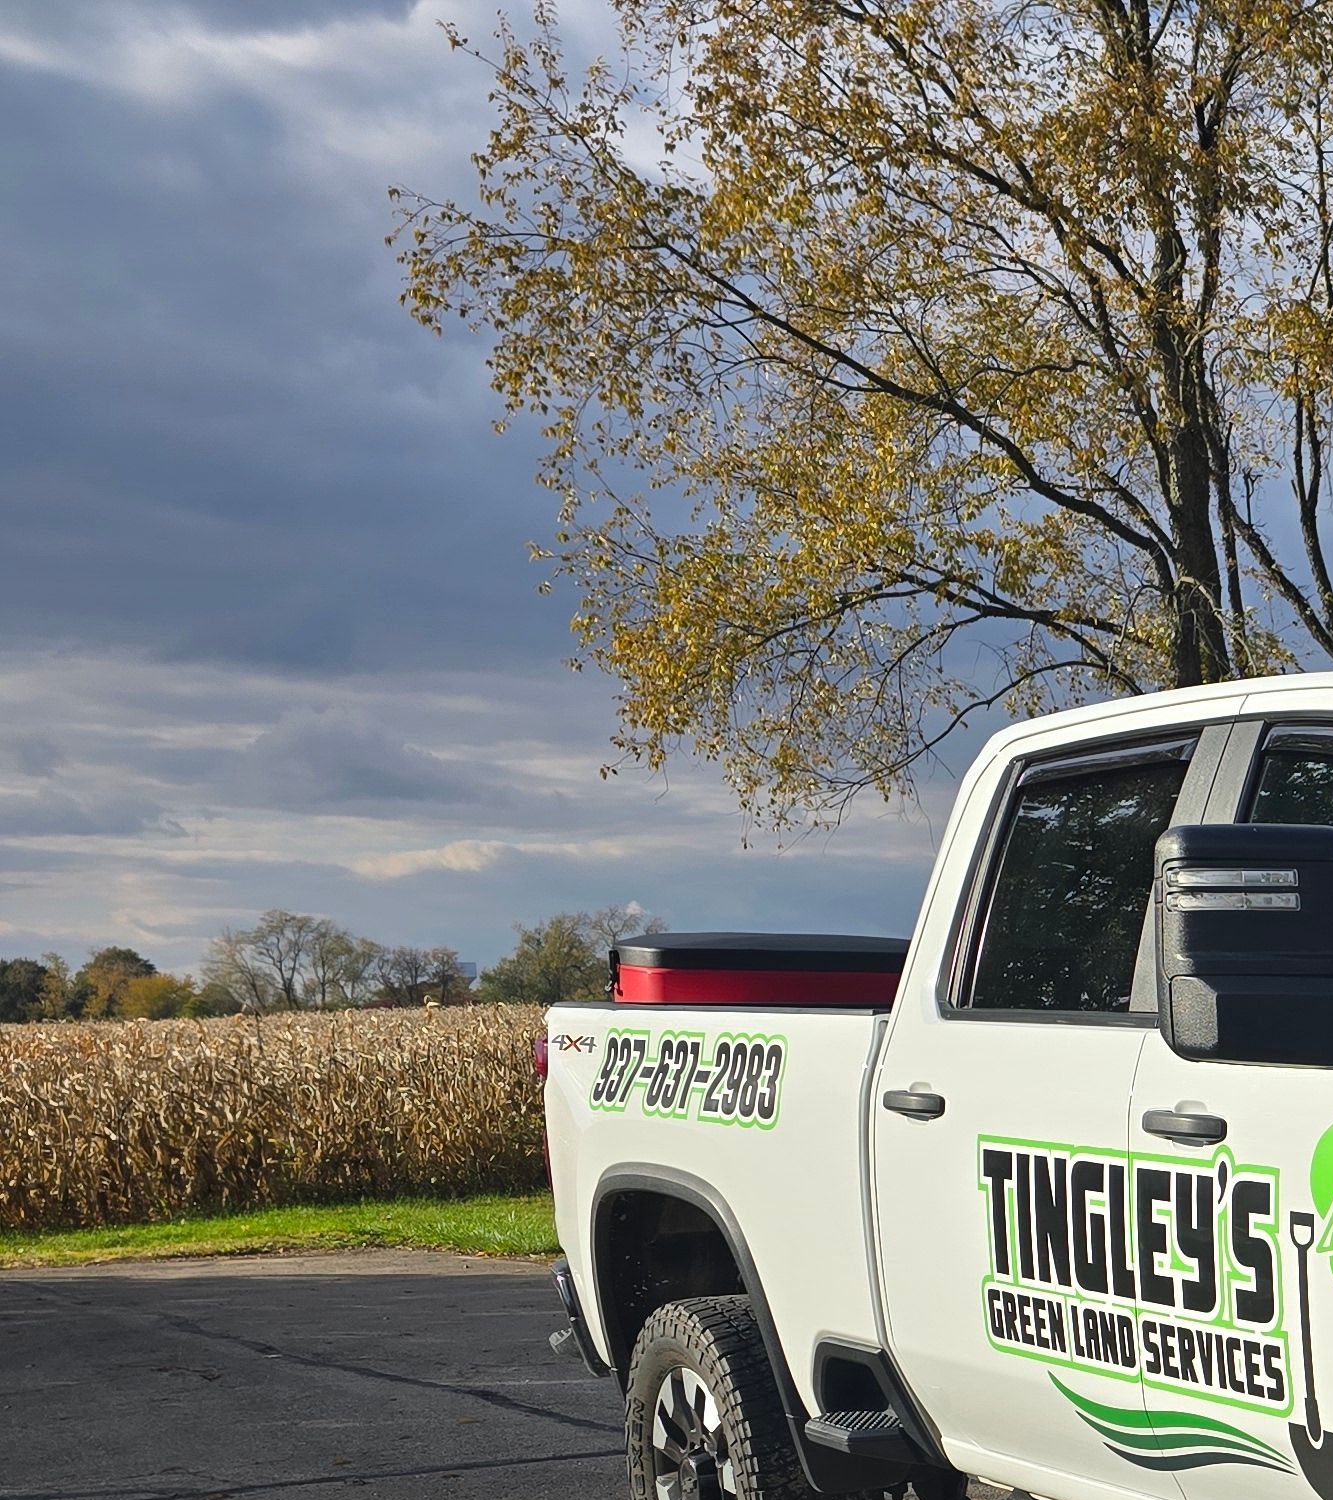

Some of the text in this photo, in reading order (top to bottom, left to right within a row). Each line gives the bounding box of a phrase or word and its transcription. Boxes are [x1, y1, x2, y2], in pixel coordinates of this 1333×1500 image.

[593, 1037, 782, 1119] 937-631-2983
[983, 1148, 1275, 1324] TINGLEY'S
[987, 1288, 1285, 1402] GREEN LAND SERVICES
